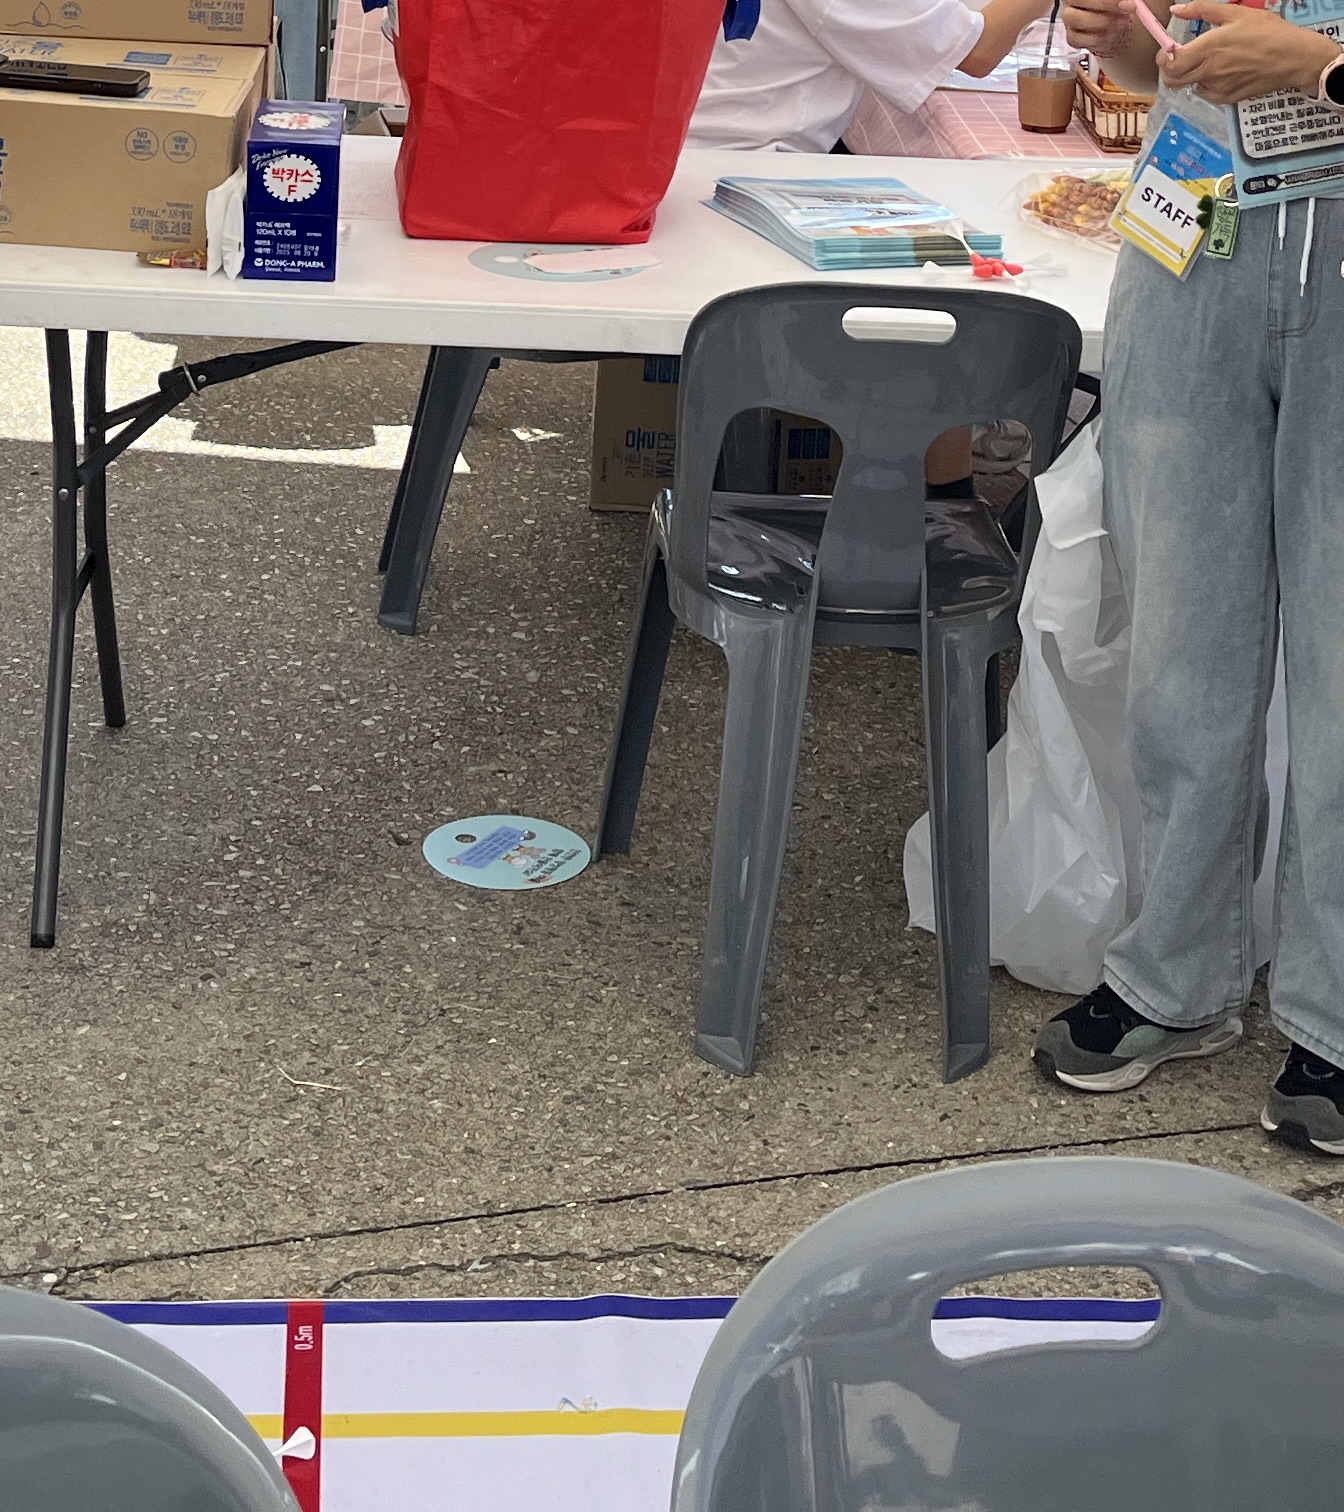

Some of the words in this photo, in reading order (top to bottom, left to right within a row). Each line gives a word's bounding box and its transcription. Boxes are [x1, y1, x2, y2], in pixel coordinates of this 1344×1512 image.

[271, 167, 314, 183] 박카스
[287, 184, 297, 196] F
[1141, 186, 1194, 229] STAFF
[264, 259, 296, 268] DONG-A
[655, 431, 676, 480] WATER
[293, 1325, 314, 1351] 0.5m
